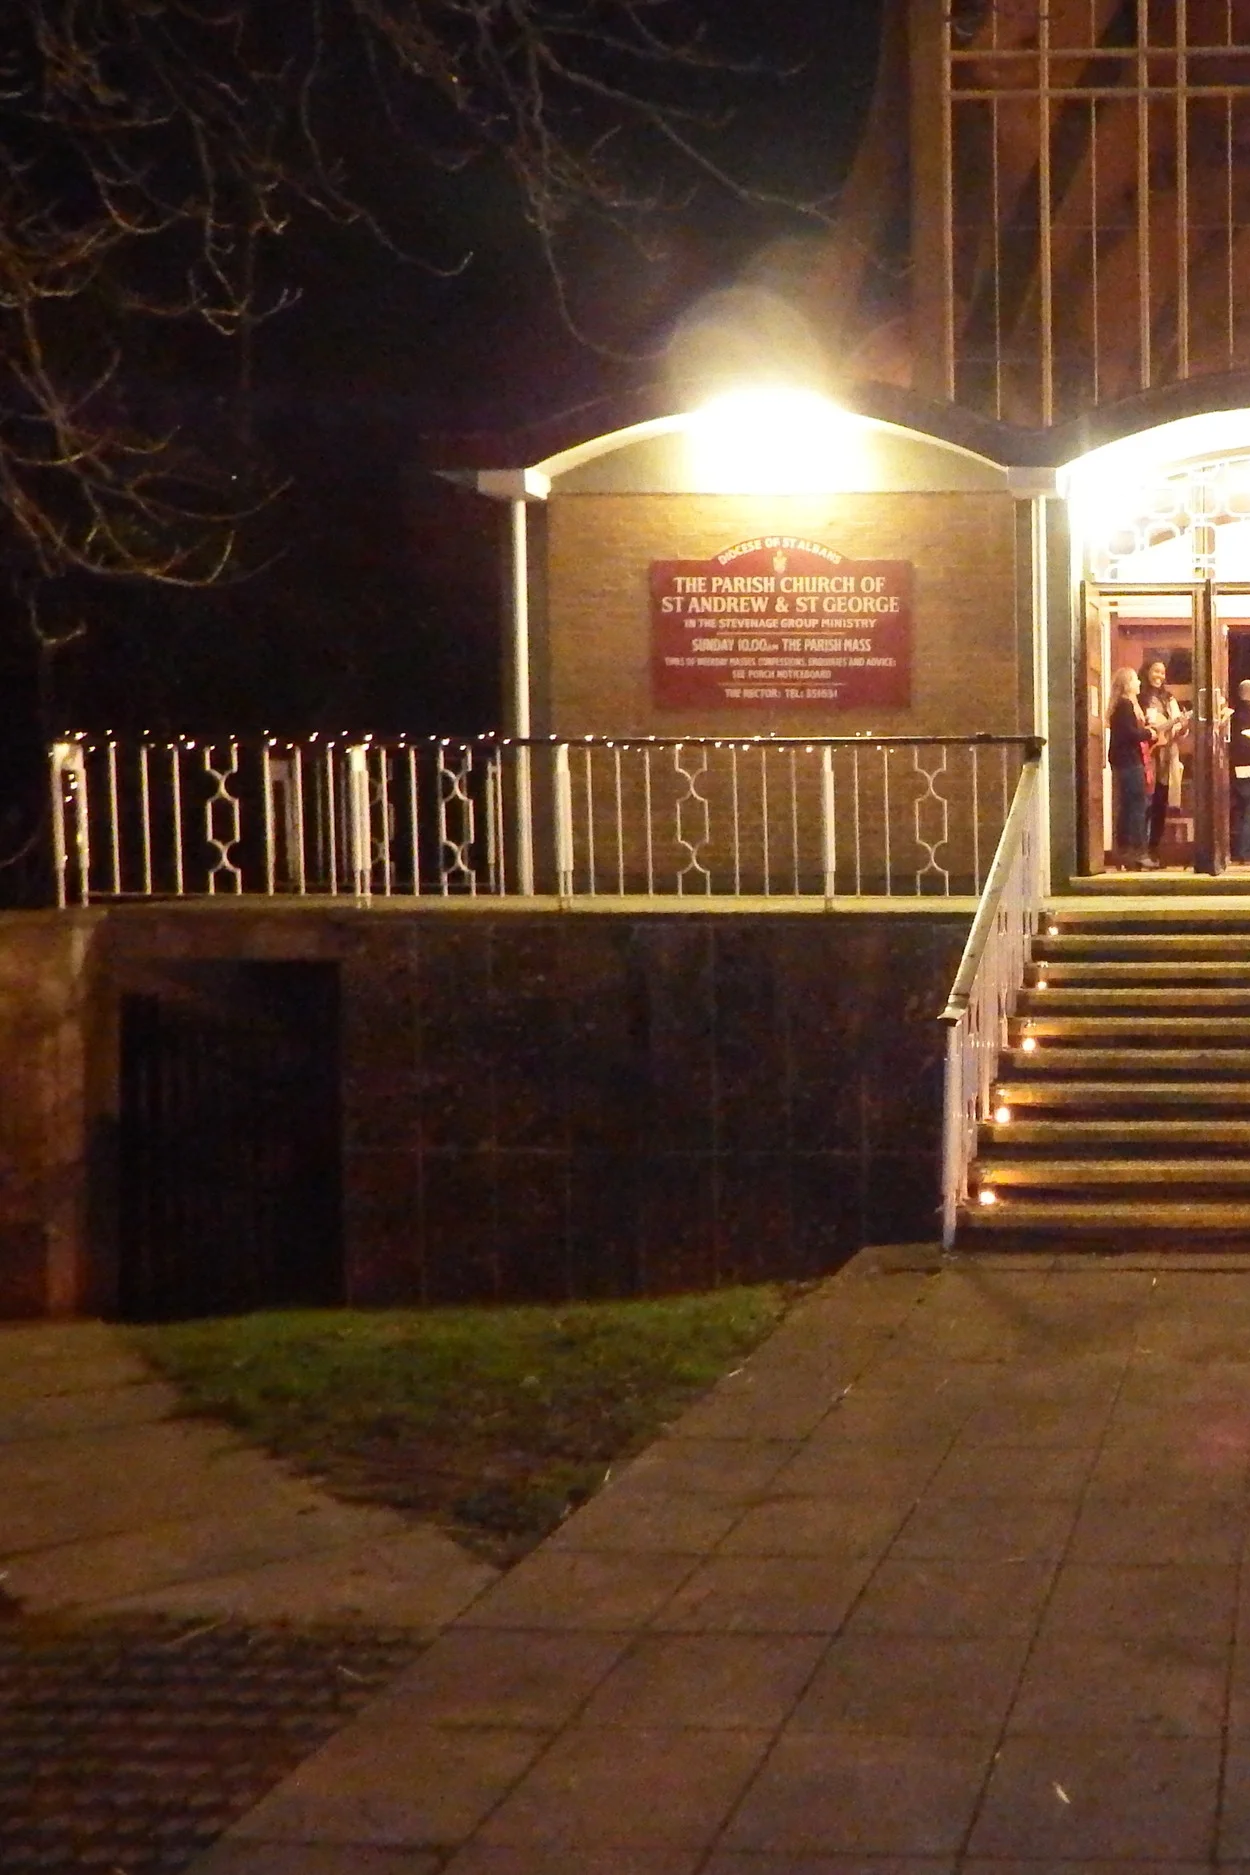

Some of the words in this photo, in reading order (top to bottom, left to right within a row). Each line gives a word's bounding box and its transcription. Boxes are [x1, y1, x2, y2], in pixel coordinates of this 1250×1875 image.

[718, 539, 763, 566] DIOCESE
[764, 537, 780, 548] OF
[782, 537, 797, 549] ST
[797, 540, 842, 565] ALBANS
[673, 576, 707, 593] THE
[712, 576, 775, 593] PARISH
[780, 576, 855, 593] CHURCH
[860, 576, 885, 593] OF
[661, 596, 685, 613] ST
[687, 596, 769, 613] ANDREW
[774, 597, 789, 613] &
[795, 596, 820, 613] ST
[822, 596, 900, 613] GEORGE
[683, 618, 697, 628] IN
[698, 618, 717, 628] THE
[719, 618, 779, 628] STEVENAGE
[780, 618, 819, 629] GROUP
[821, 618, 878, 628] MINISTRY
[692, 638, 735, 652] SUNDAY
[782, 638, 802, 652] THE
[804, 638, 842, 652] PARISH
[844, 638, 872, 652] MASS
[748, 669, 775, 679] PORCH
